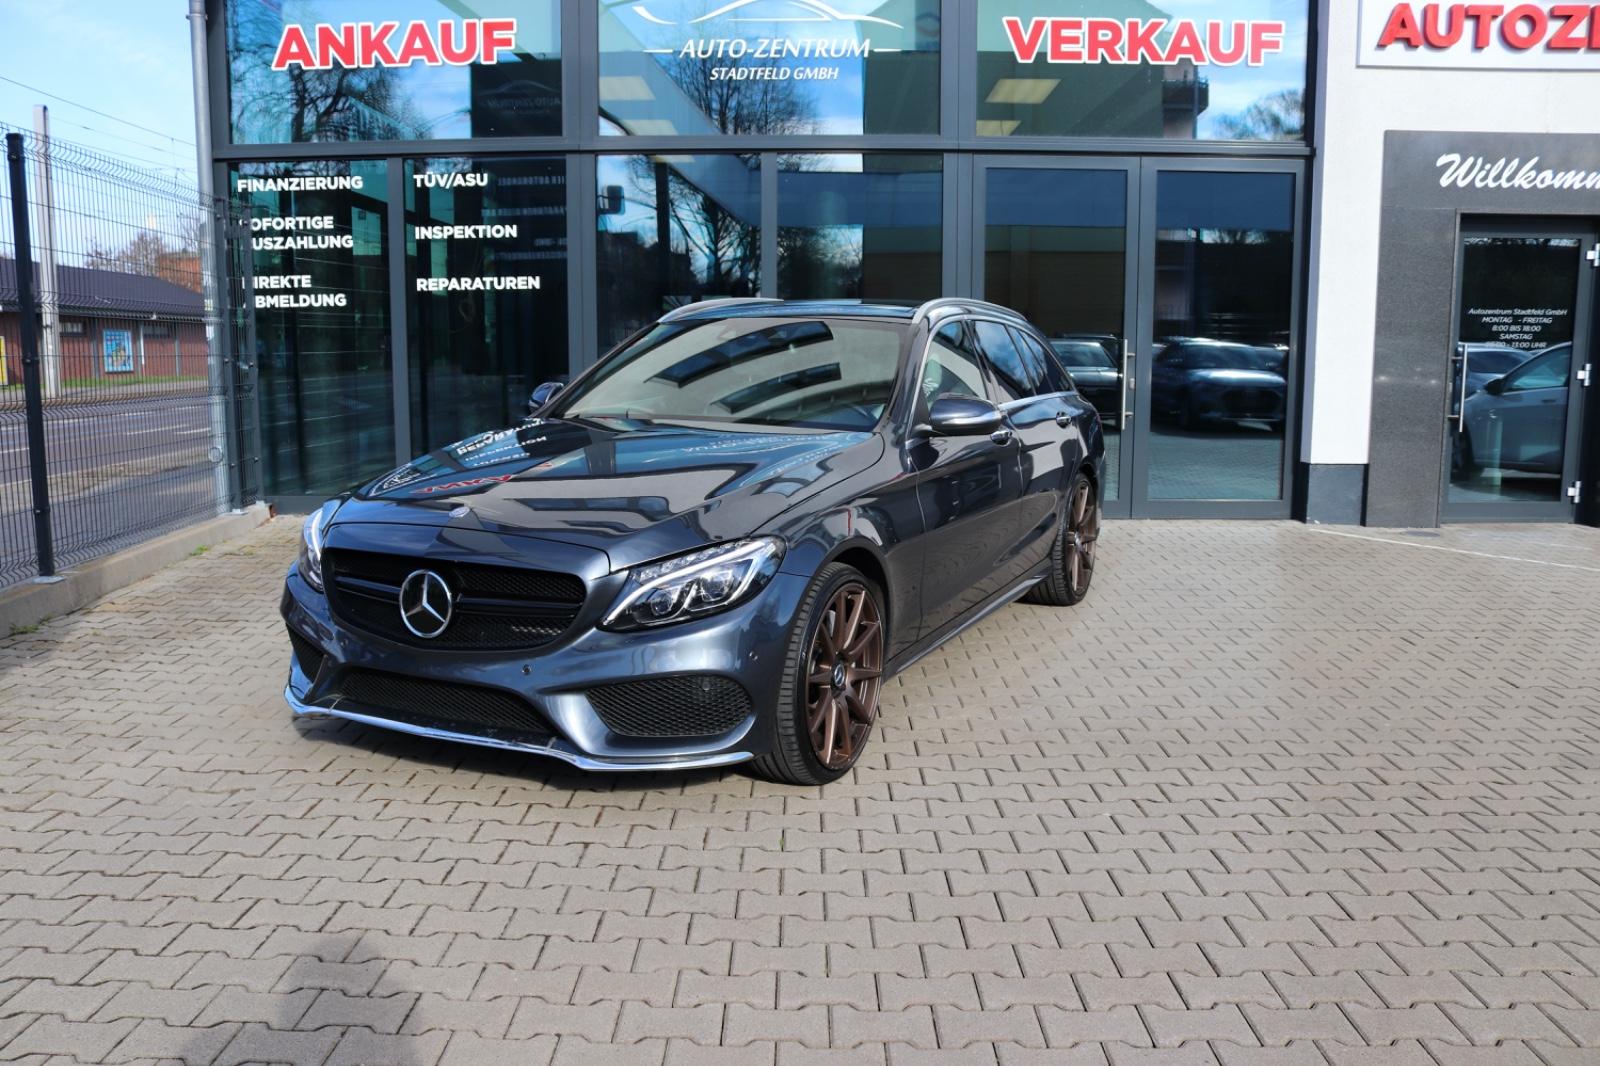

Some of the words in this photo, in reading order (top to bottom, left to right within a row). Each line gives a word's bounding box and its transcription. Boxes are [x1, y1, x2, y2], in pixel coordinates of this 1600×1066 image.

[271, 18, 517, 70] ANKAUF
[679, 38, 871, 58] AUTO-ZENTRUM
[1002, 16, 1285, 66] VERKAUF
[709, 67, 791, 80] STADTFELD
[793, 67, 839, 80] GMBH
[237, 176, 364, 192] FINANZIERUNG
[413, 172, 488, 189] TÜV/ASU
[240, 216, 334, 231] OFORTIGE
[414, 224, 518, 240] INSPEKTION
[242, 235, 354, 250] USZAHLUNG
[242, 275, 312, 289] IREKTE
[416, 276, 540, 291] REPARATUREN
[243, 293, 347, 308] BMELDUNG
[1468, 307, 1513, 315] Autozentrum
[1546, 308, 1568, 316] GmbH
